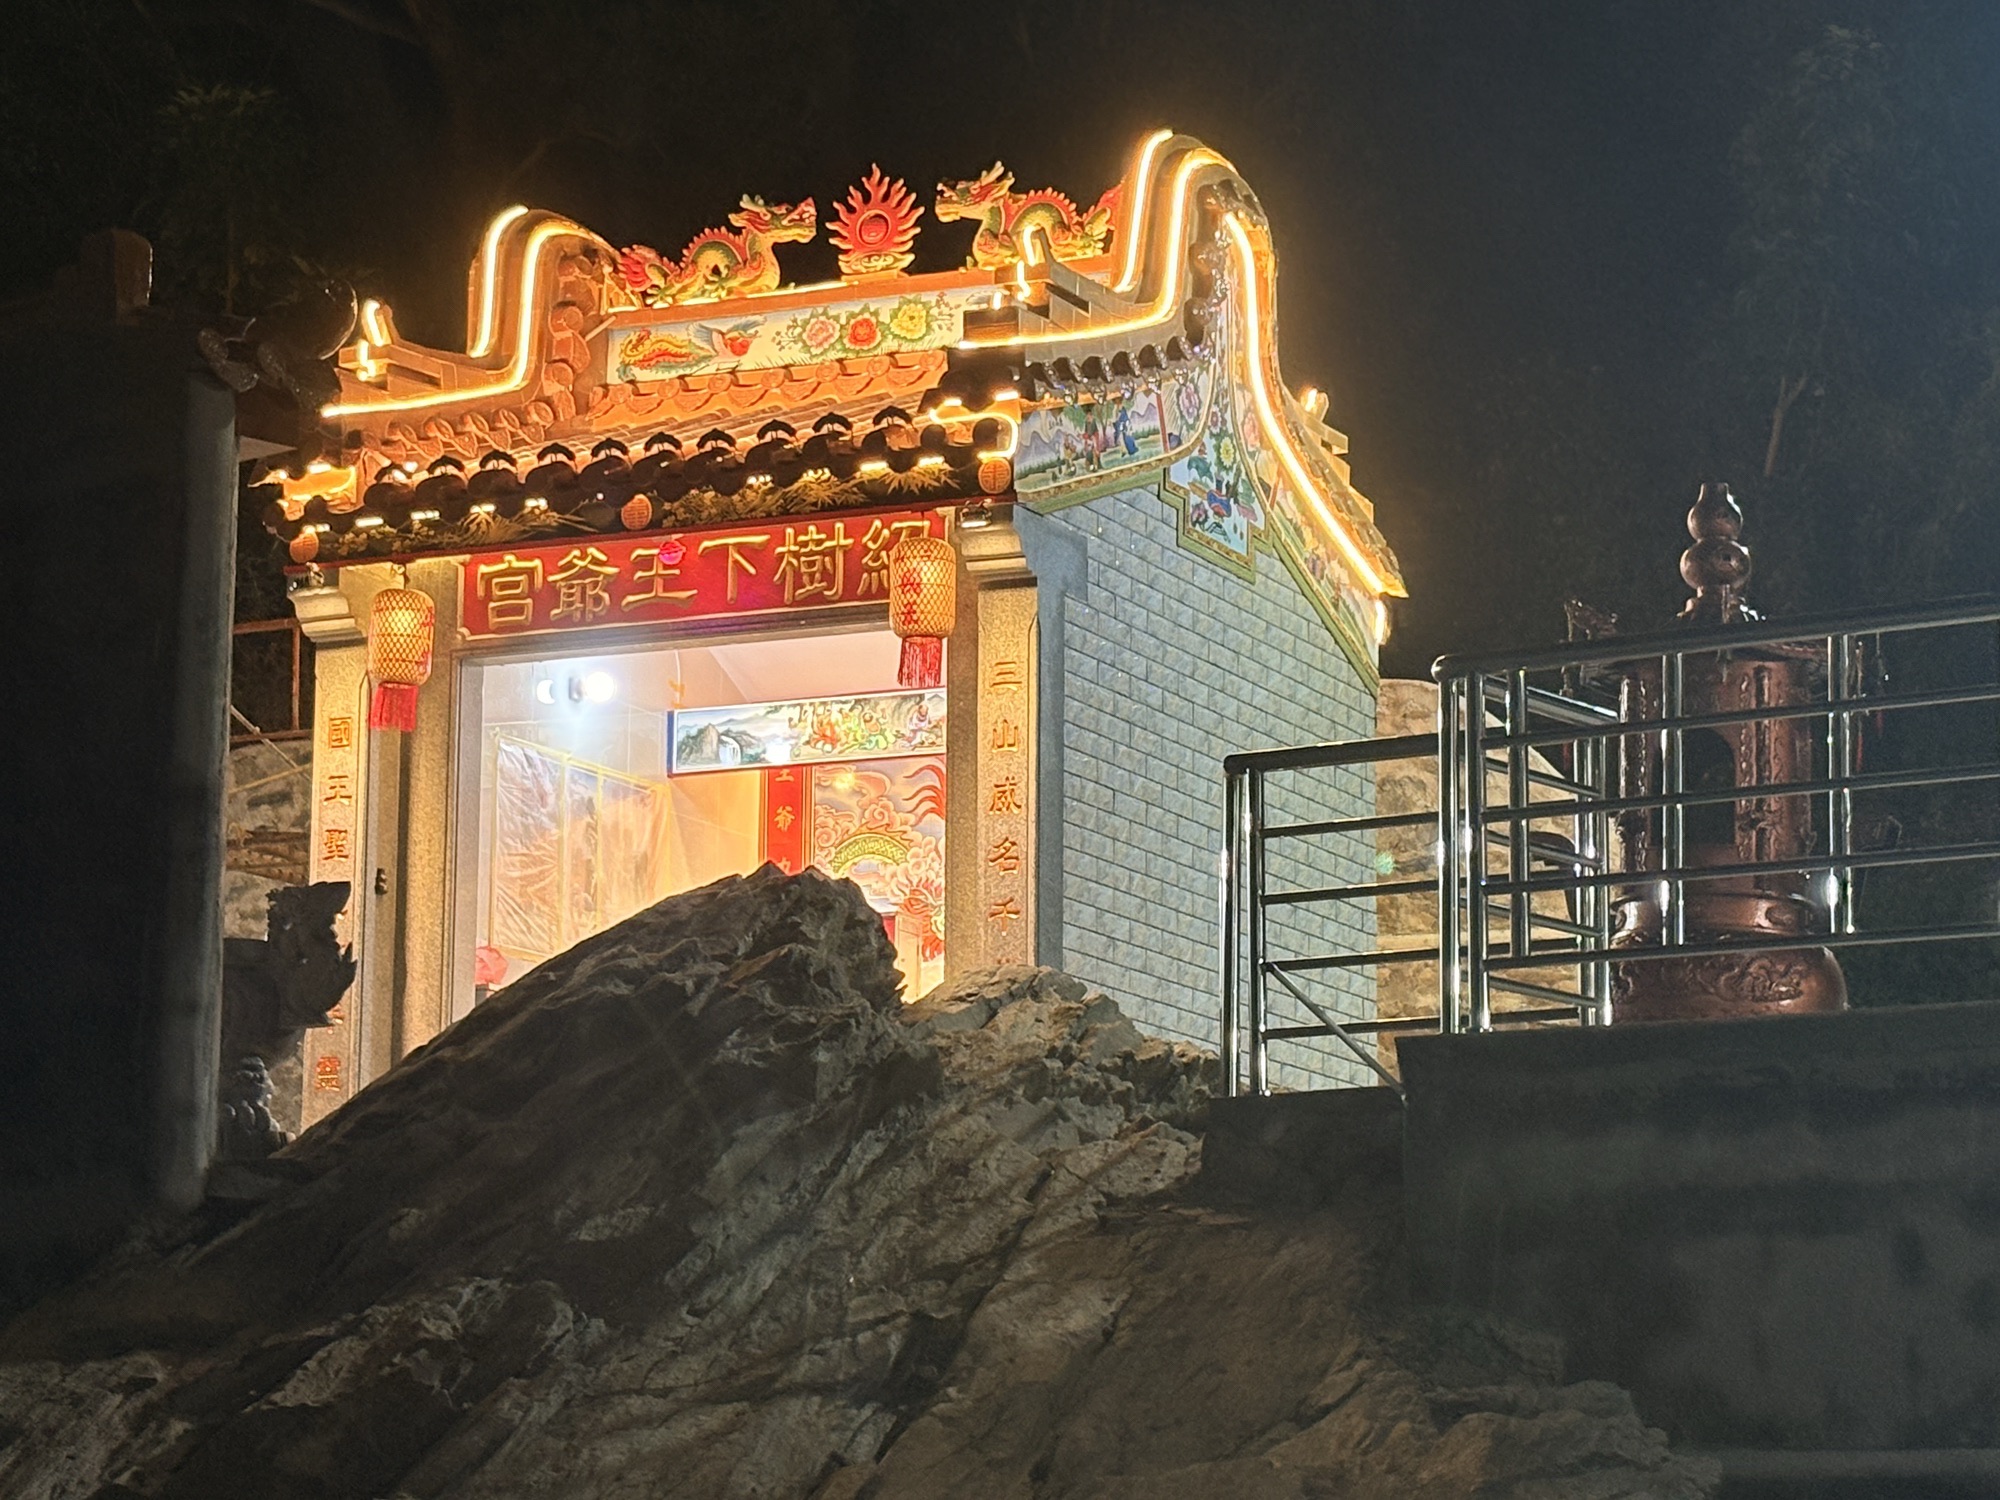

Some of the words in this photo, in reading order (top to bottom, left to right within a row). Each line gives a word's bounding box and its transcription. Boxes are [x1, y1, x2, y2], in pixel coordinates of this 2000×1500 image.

[988, 660, 1022, 964] 三山威名千
